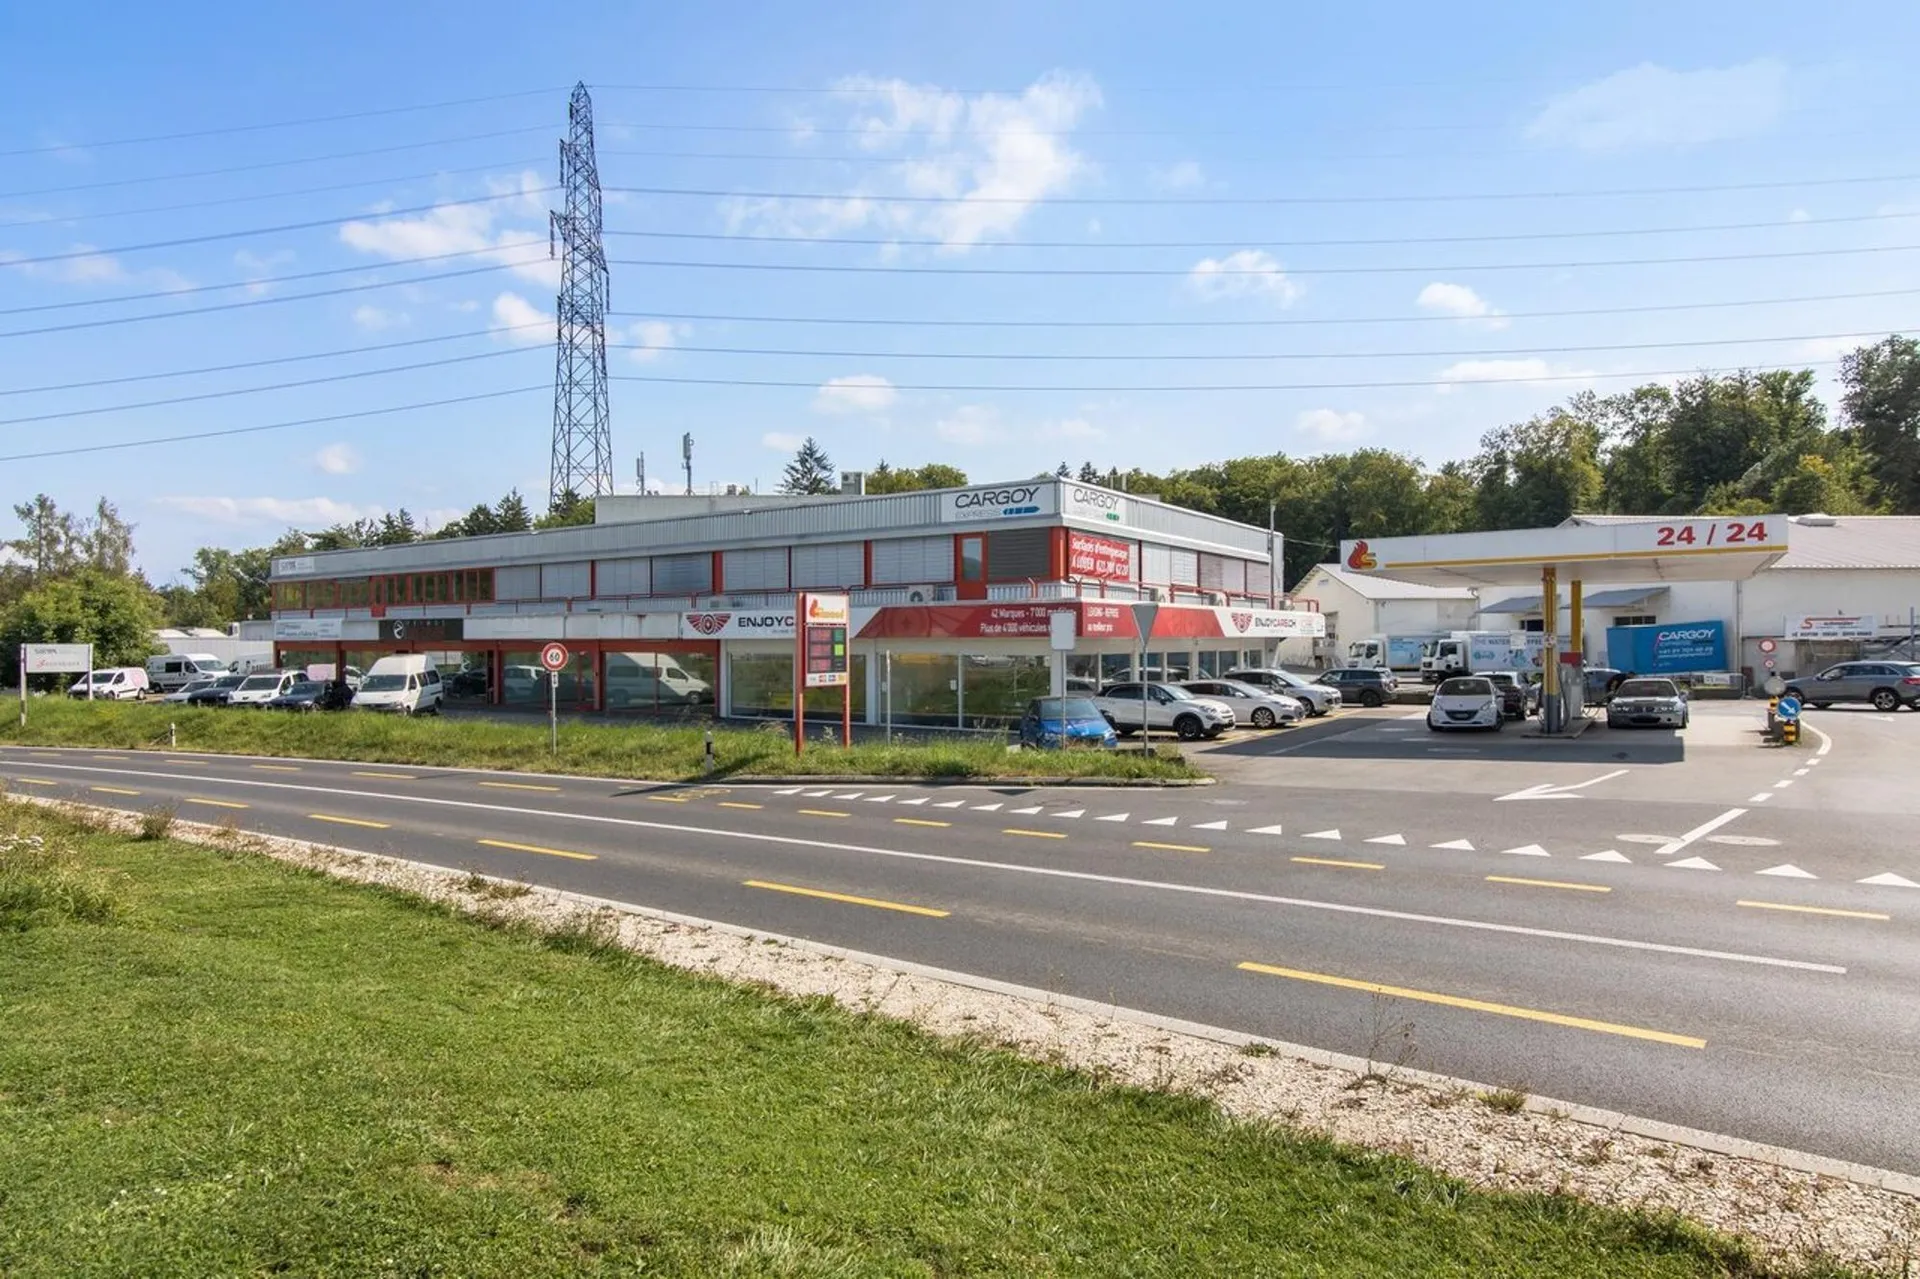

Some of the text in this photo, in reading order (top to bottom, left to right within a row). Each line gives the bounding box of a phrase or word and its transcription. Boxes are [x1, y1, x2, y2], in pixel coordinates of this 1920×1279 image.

[955, 487, 1040, 508] CARGOY
[1073, 488, 1119, 510] CARGOY
[1657, 521, 1768, 546] 24 / 24
[738, 616, 794, 628] ENJOYC
[1658, 628, 1716, 641] CARGOY
[549, 651, 560, 662] 60
